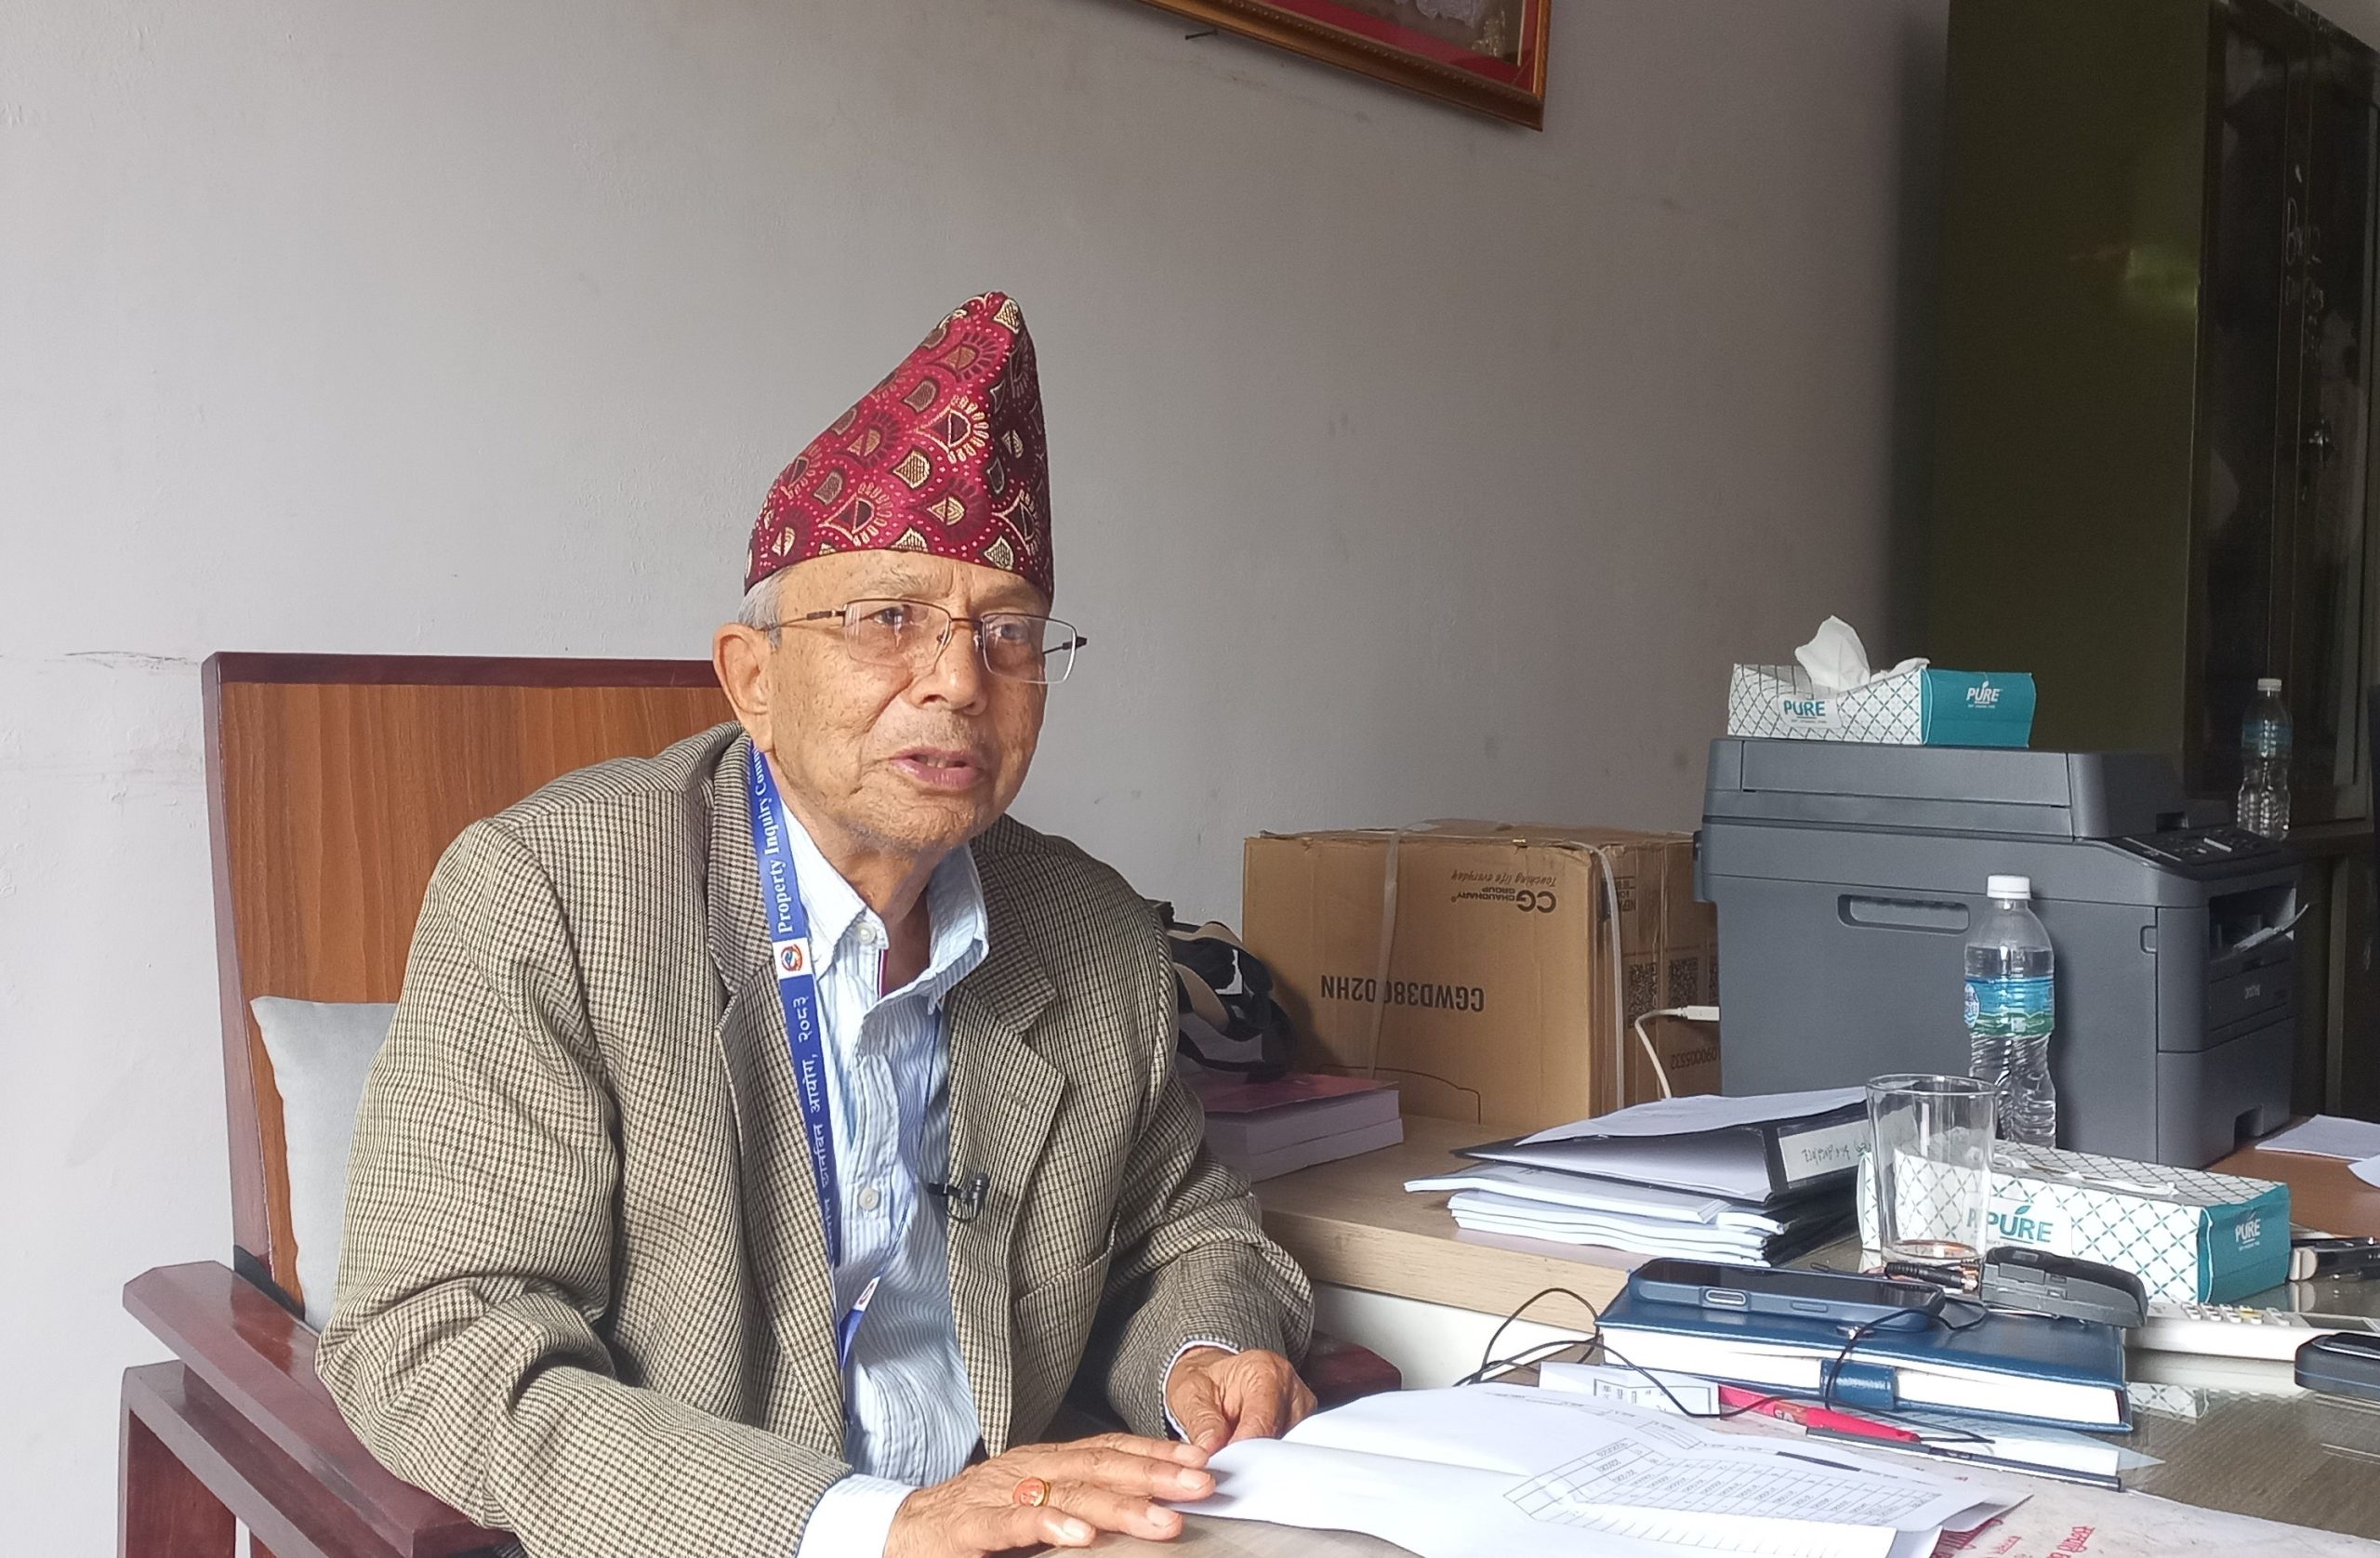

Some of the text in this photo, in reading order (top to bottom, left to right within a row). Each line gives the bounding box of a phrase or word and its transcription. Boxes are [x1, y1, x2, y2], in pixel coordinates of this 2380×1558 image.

[1965, 686, 2001, 702] PURE
[1783, 700, 1826, 717] PURE
[758, 798, 779, 855] Inquiry
[1495, 872, 1513, 885] life
[1514, 871, 1556, 887] Touching
[770, 859, 793, 933] Property
[1515, 890, 1556, 913] CG
[793, 996, 813, 1043] २०८३
[801, 1053, 820, 1114] आयोग,
[1987, 1211, 2054, 1243] PURE
[2235, 1219, 2261, 1243] PURE
